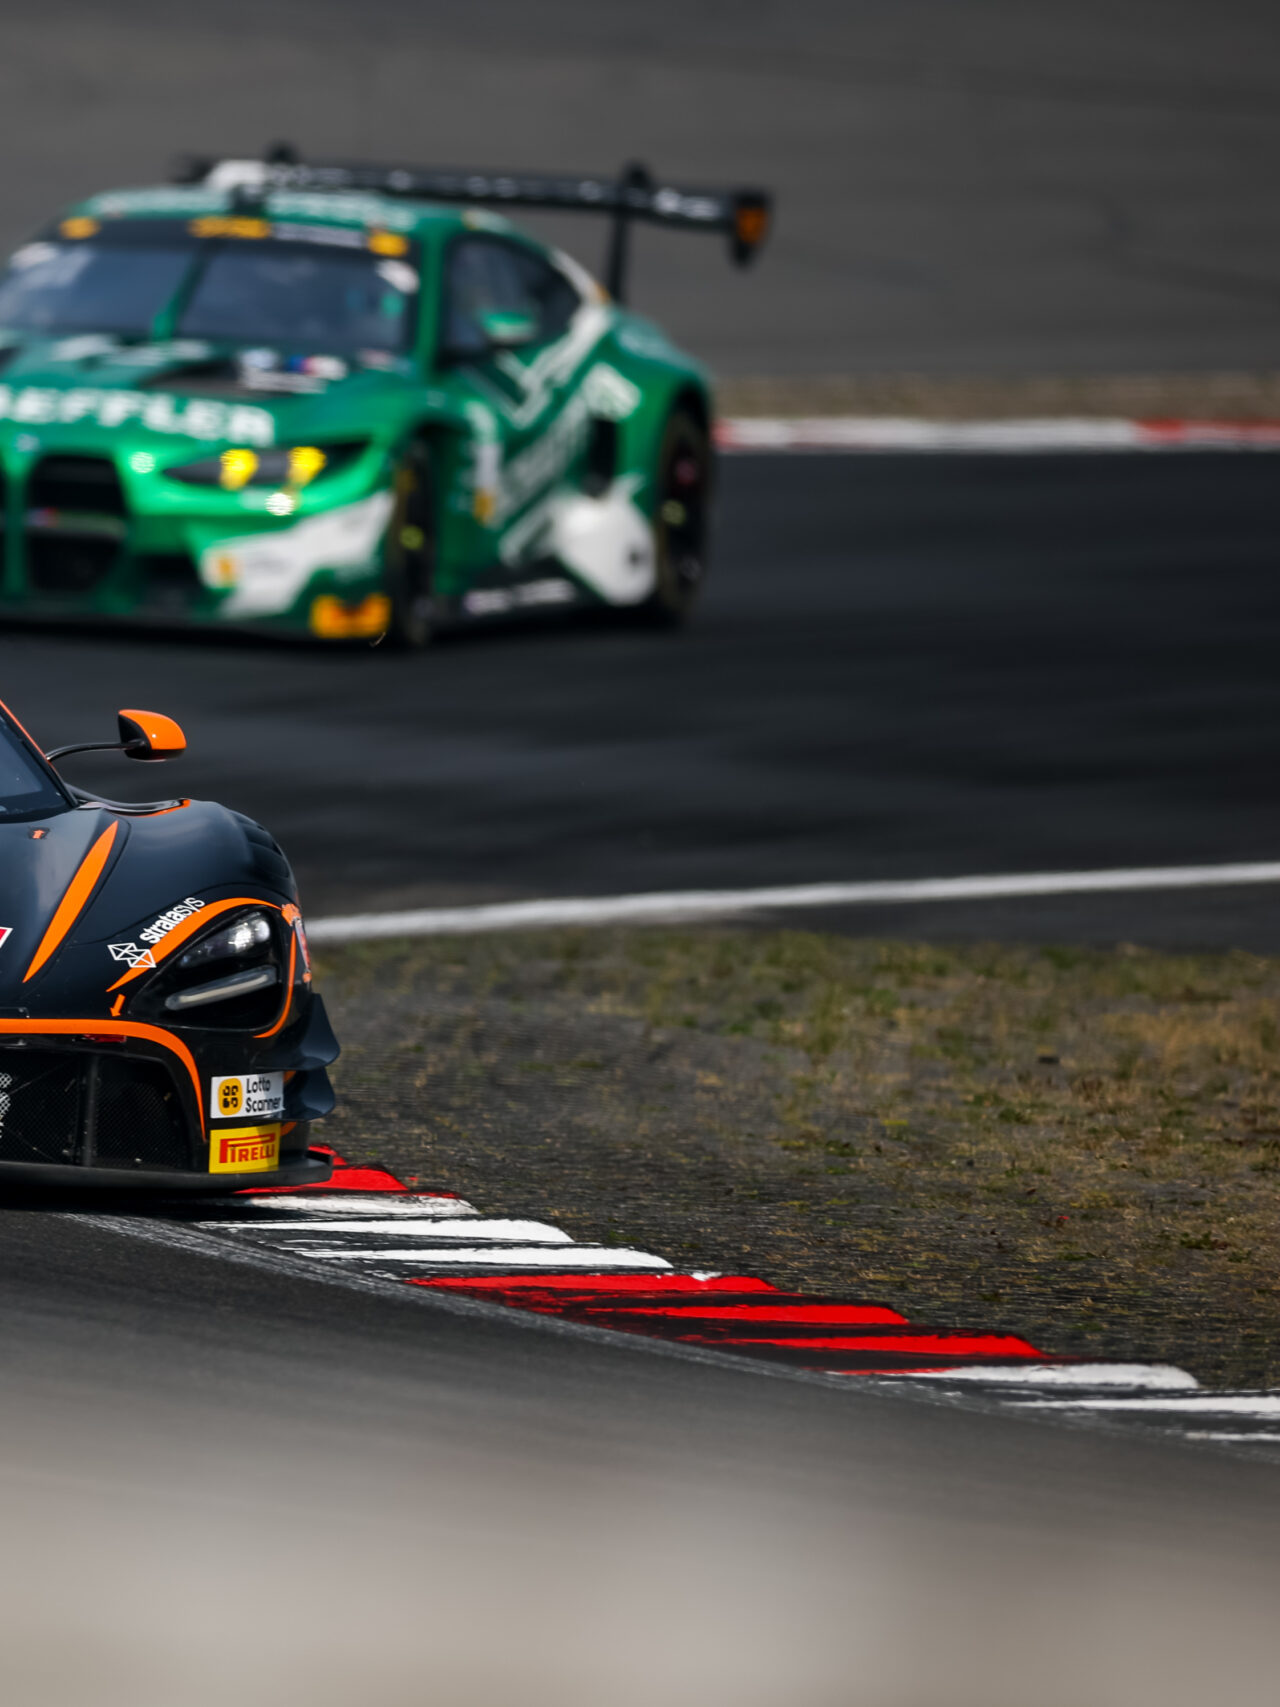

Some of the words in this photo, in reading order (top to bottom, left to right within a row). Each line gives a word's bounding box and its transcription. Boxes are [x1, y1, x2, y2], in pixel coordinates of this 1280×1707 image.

[139, 897, 205, 944] stratasys
[247, 1078, 271, 1093] Lotto
[245, 1096, 282, 1113] Scanner
[219, 1132, 276, 1163] PIRELLI
